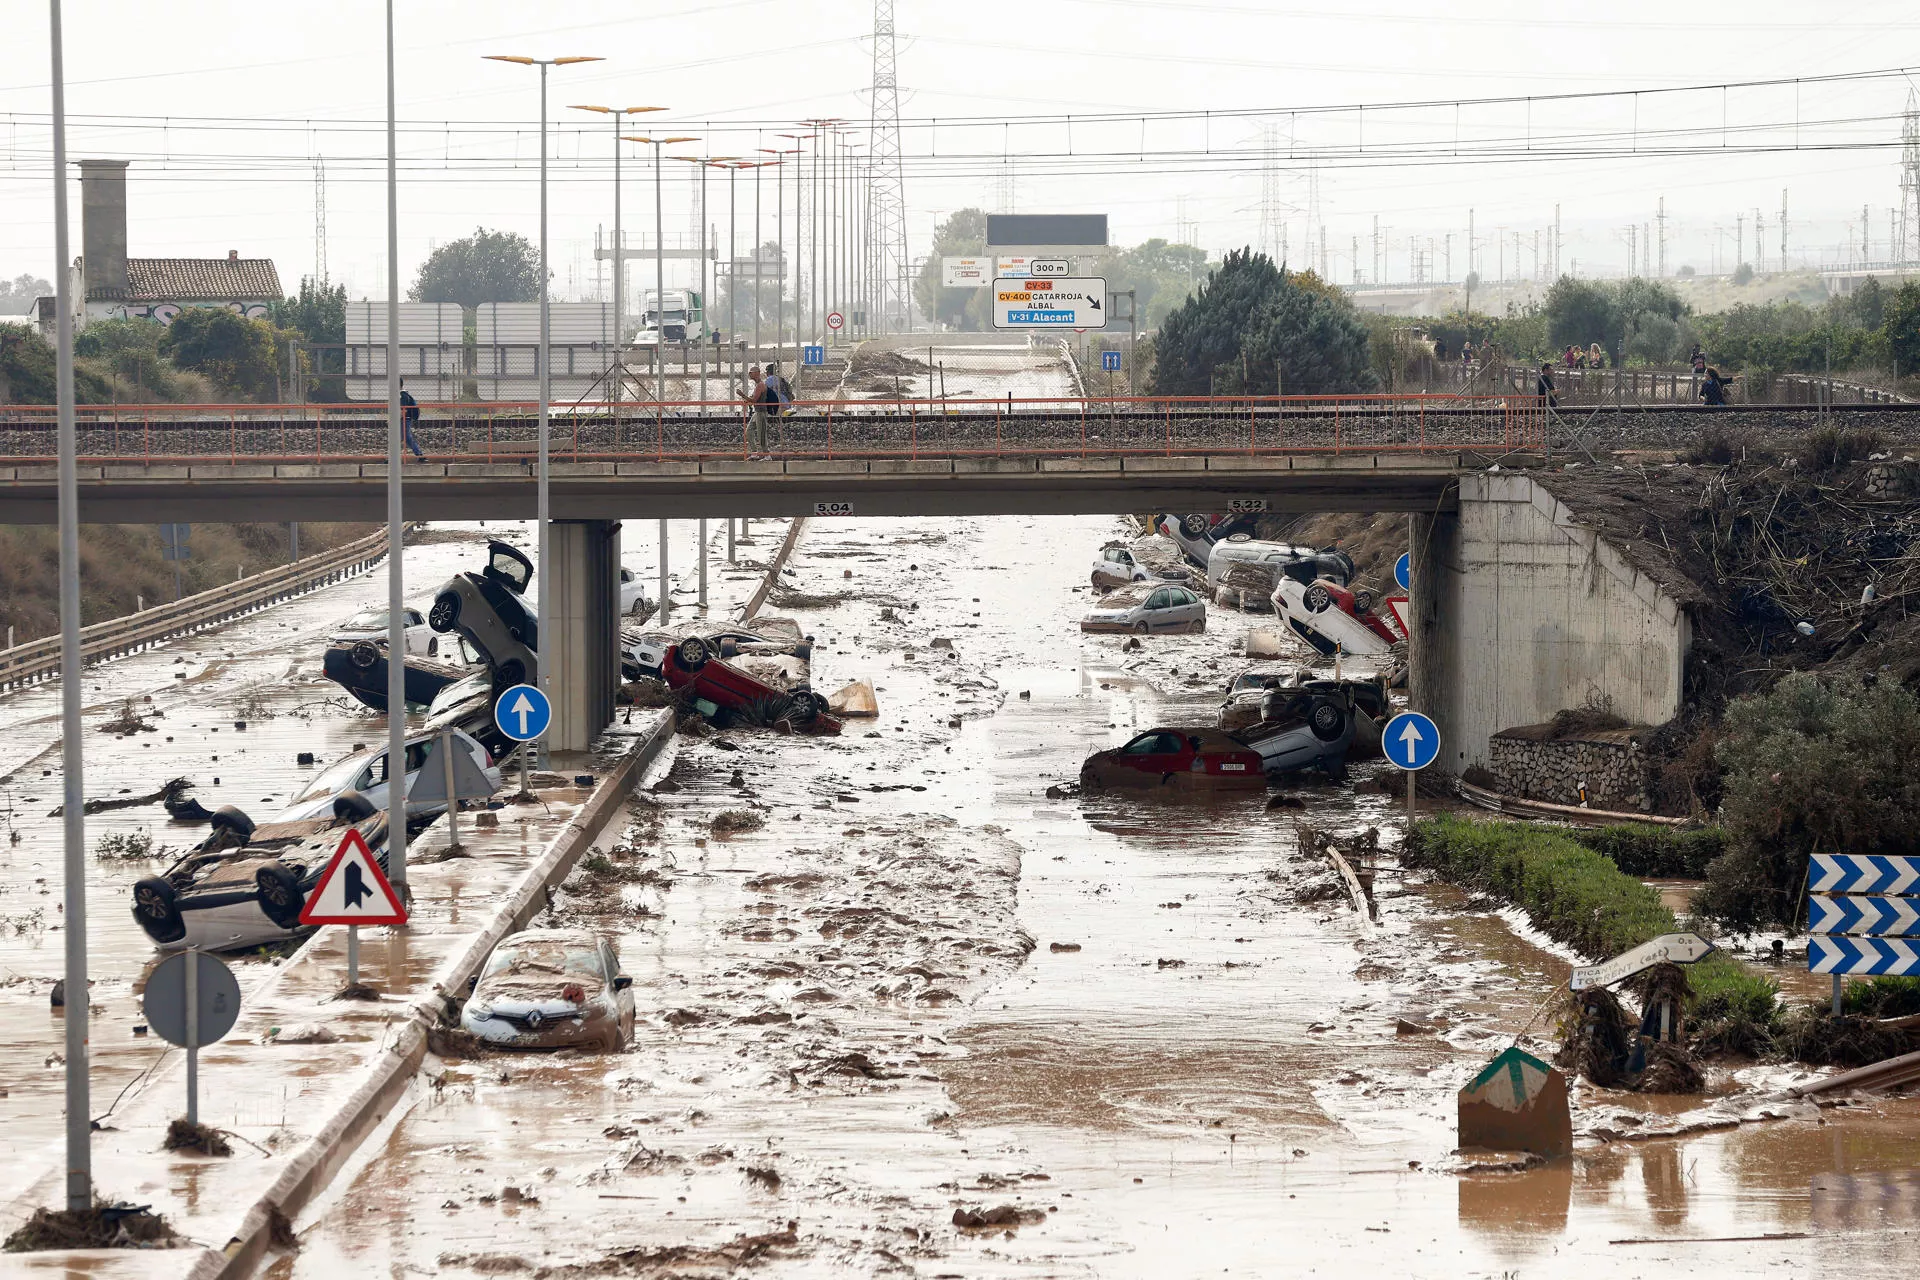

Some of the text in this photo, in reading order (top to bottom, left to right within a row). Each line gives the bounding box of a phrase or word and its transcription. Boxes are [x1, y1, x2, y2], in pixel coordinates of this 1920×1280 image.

[1036, 264, 1054, 272] 300
[1026, 282, 1052, 290] CV-33
[1011, 312, 1074, 322] V-31 Alacant
[818, 503, 850, 512] 5.04
[1232, 500, 1262, 508] 5.22
[1688, 947, 1693, 957] 1
